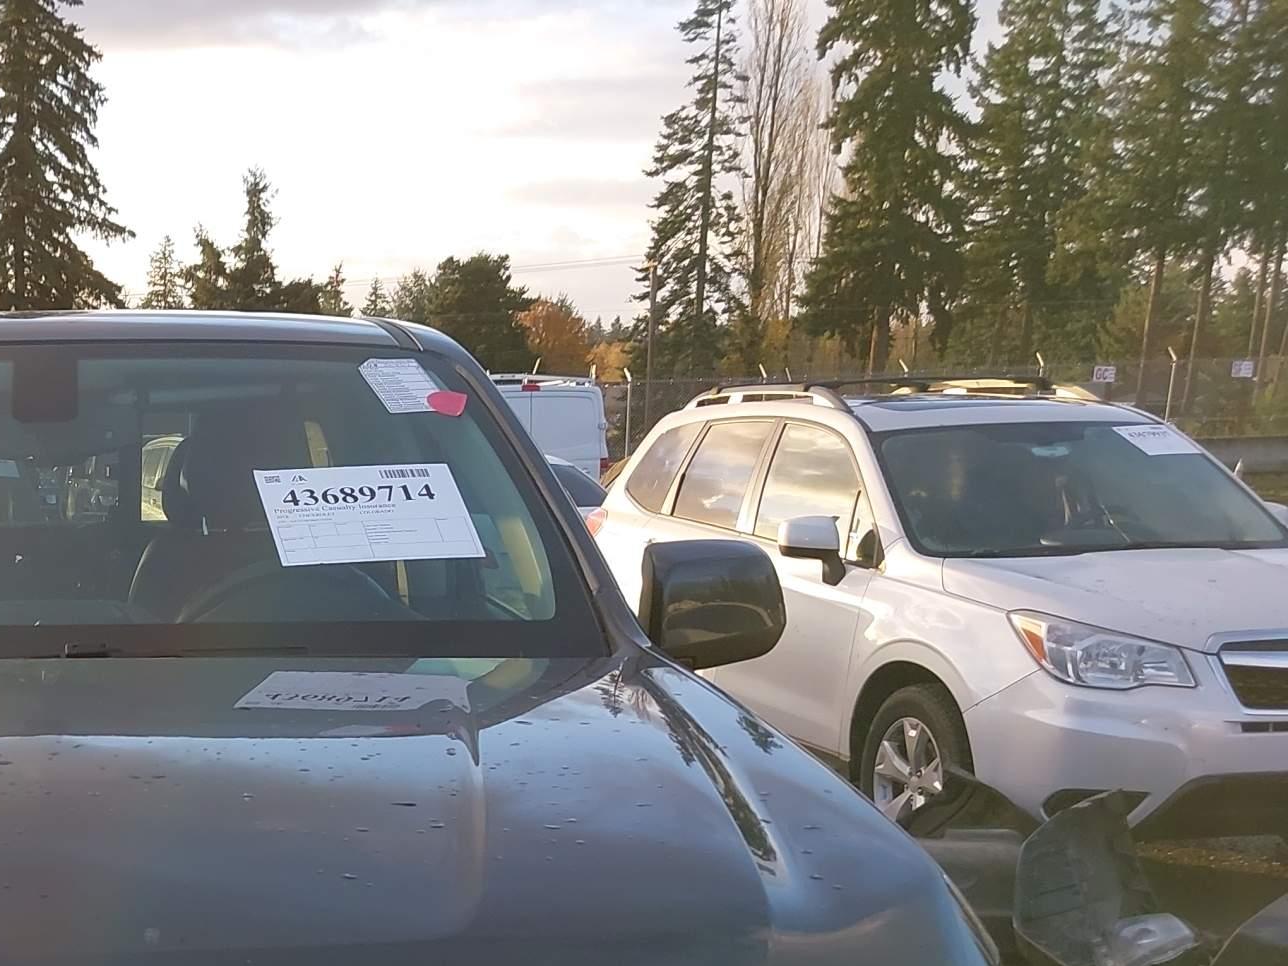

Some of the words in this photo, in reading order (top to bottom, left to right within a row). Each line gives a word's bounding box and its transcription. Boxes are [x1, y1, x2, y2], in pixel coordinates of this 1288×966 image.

[282, 483, 436, 507] 43689714
[274, 505, 321, 515] Progressive
[321, 503, 357, 513] Casualty
[358, 502, 396, 511] Insurance
